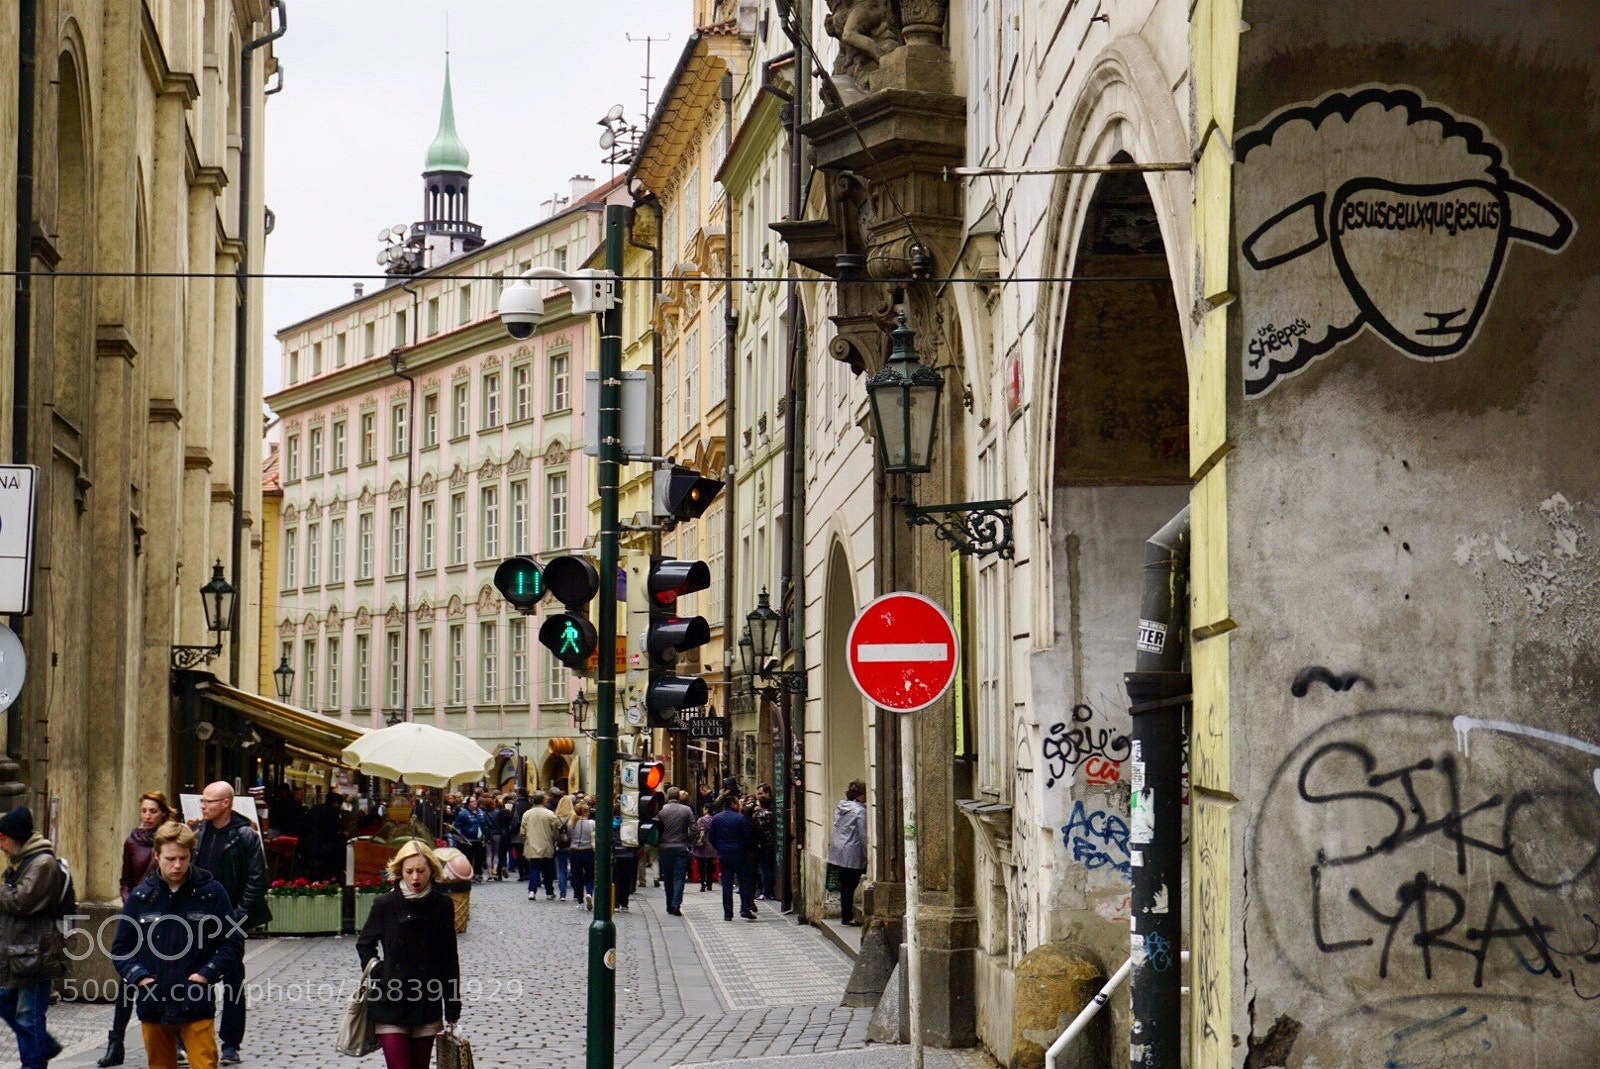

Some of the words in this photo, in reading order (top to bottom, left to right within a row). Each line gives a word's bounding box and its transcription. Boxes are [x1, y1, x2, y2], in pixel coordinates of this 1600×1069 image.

[518, 571, 540, 595] 11
[692, 719, 723, 727] MUSIC
[691, 726, 724, 737] CLUB
